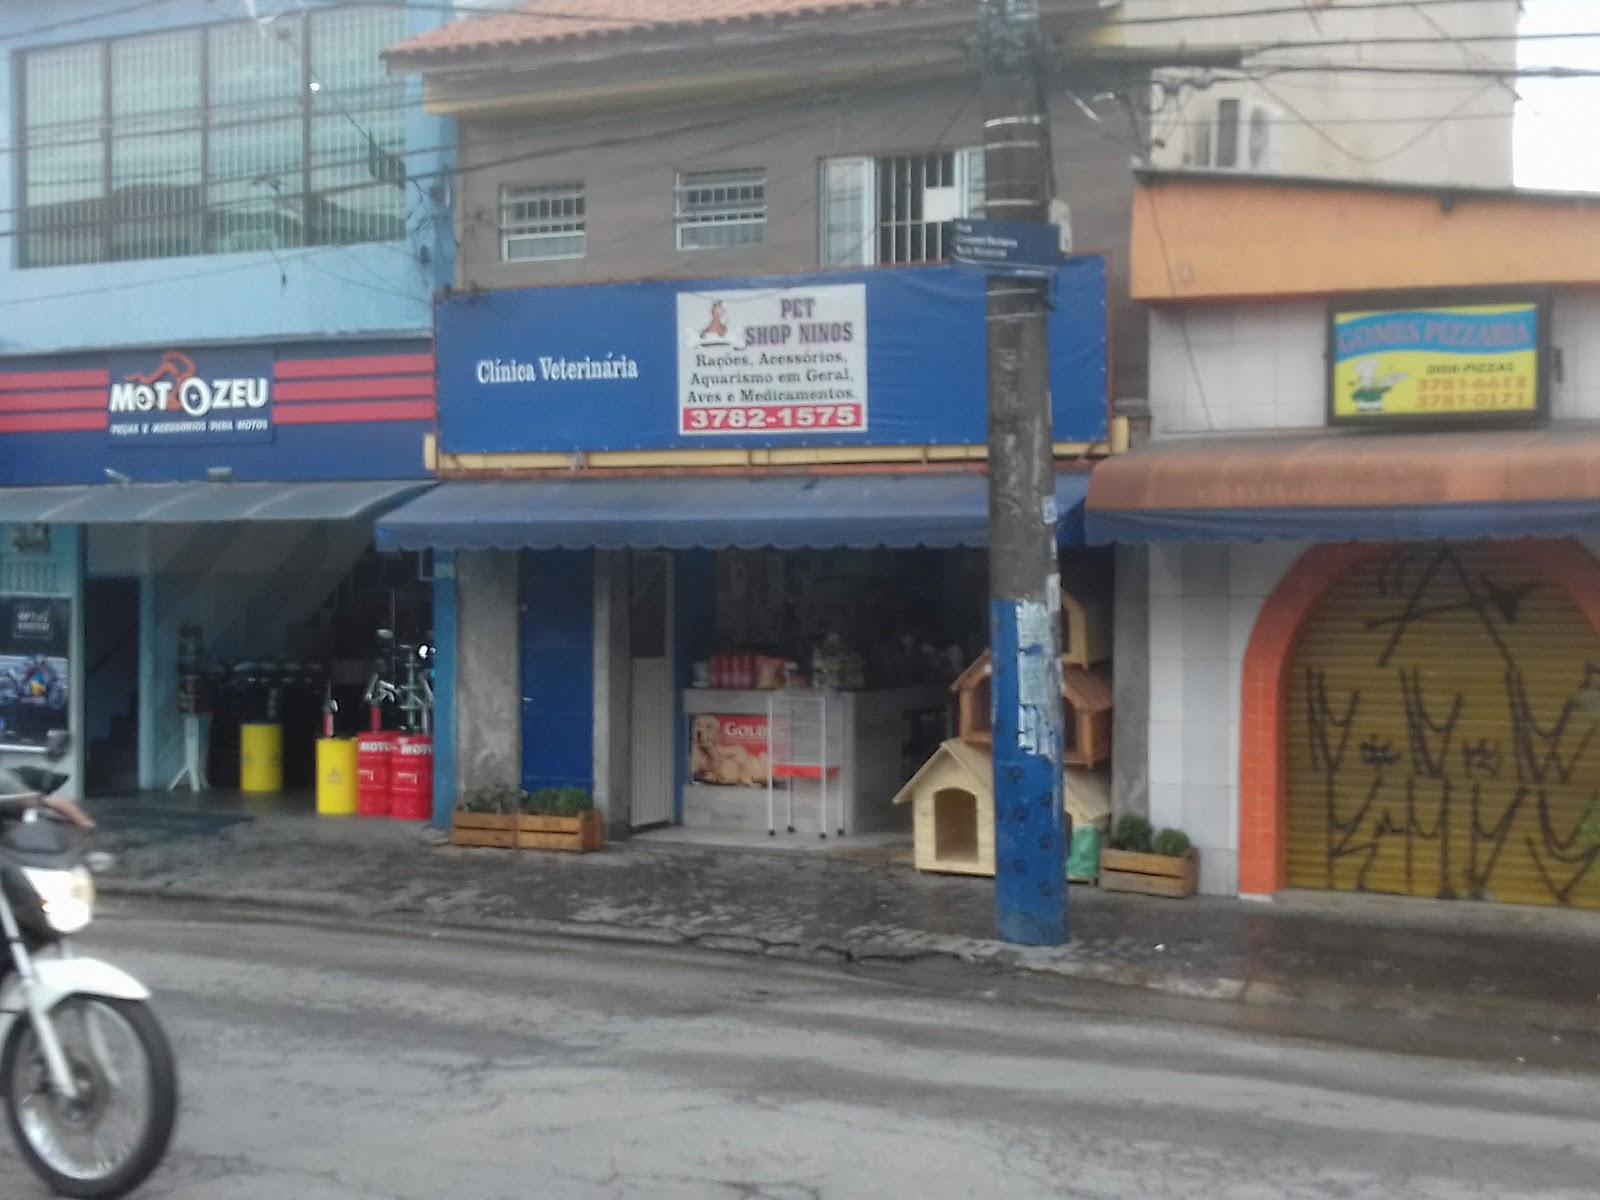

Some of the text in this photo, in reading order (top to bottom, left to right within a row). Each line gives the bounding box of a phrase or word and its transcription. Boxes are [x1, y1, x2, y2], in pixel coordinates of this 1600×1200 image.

[780, 297, 815, 319] PET
[745, 322, 853, 346] SHOP NINOS
[477, 351, 639, 384] Clínica Veterinária
[690, 372, 773, 388] Aquarismo
[778, 373, 800, 383] em
[687, 391, 722, 404] Aves
[727, 392, 736, 402] e
[691, 407, 857, 429] 3782-1575
